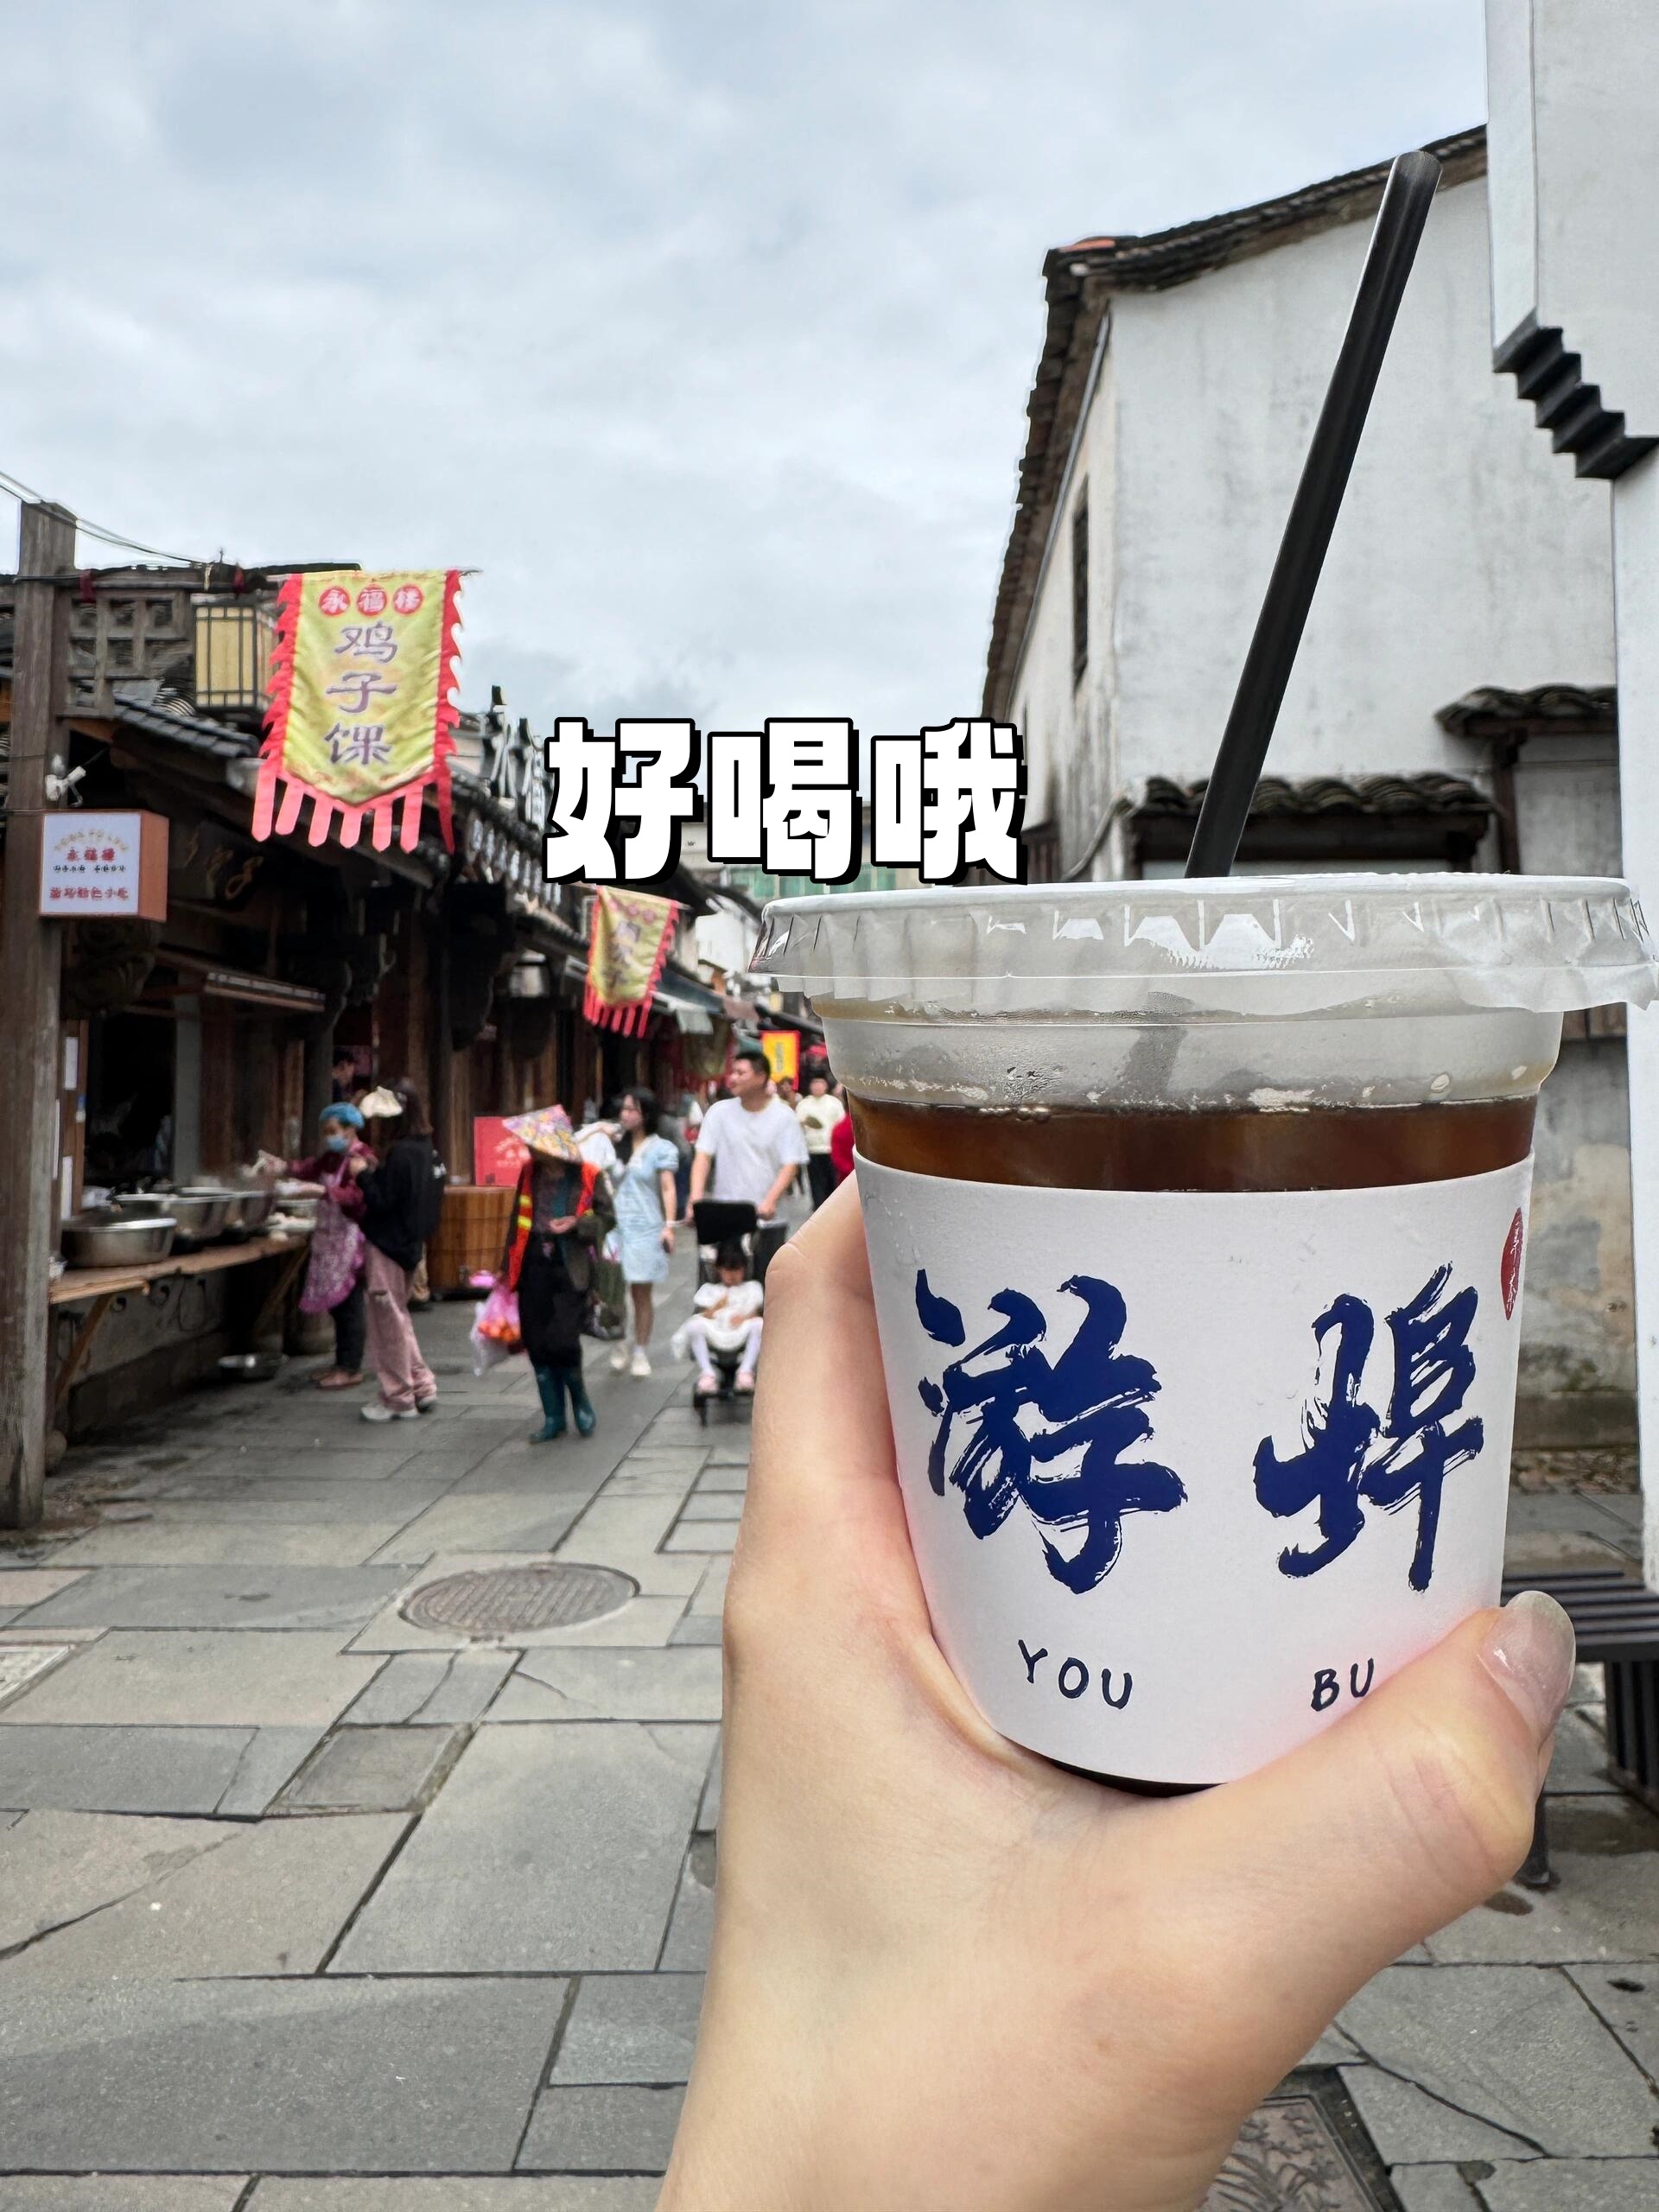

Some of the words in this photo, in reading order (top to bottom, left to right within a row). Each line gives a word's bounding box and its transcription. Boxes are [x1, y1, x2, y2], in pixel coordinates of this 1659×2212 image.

[325, 620, 397, 766] 鸡子馃
[916, 1262, 1484, 1594] 游埠
[1018, 1639, 1133, 1709] YOU
[1311, 1658, 1375, 1712] BU
